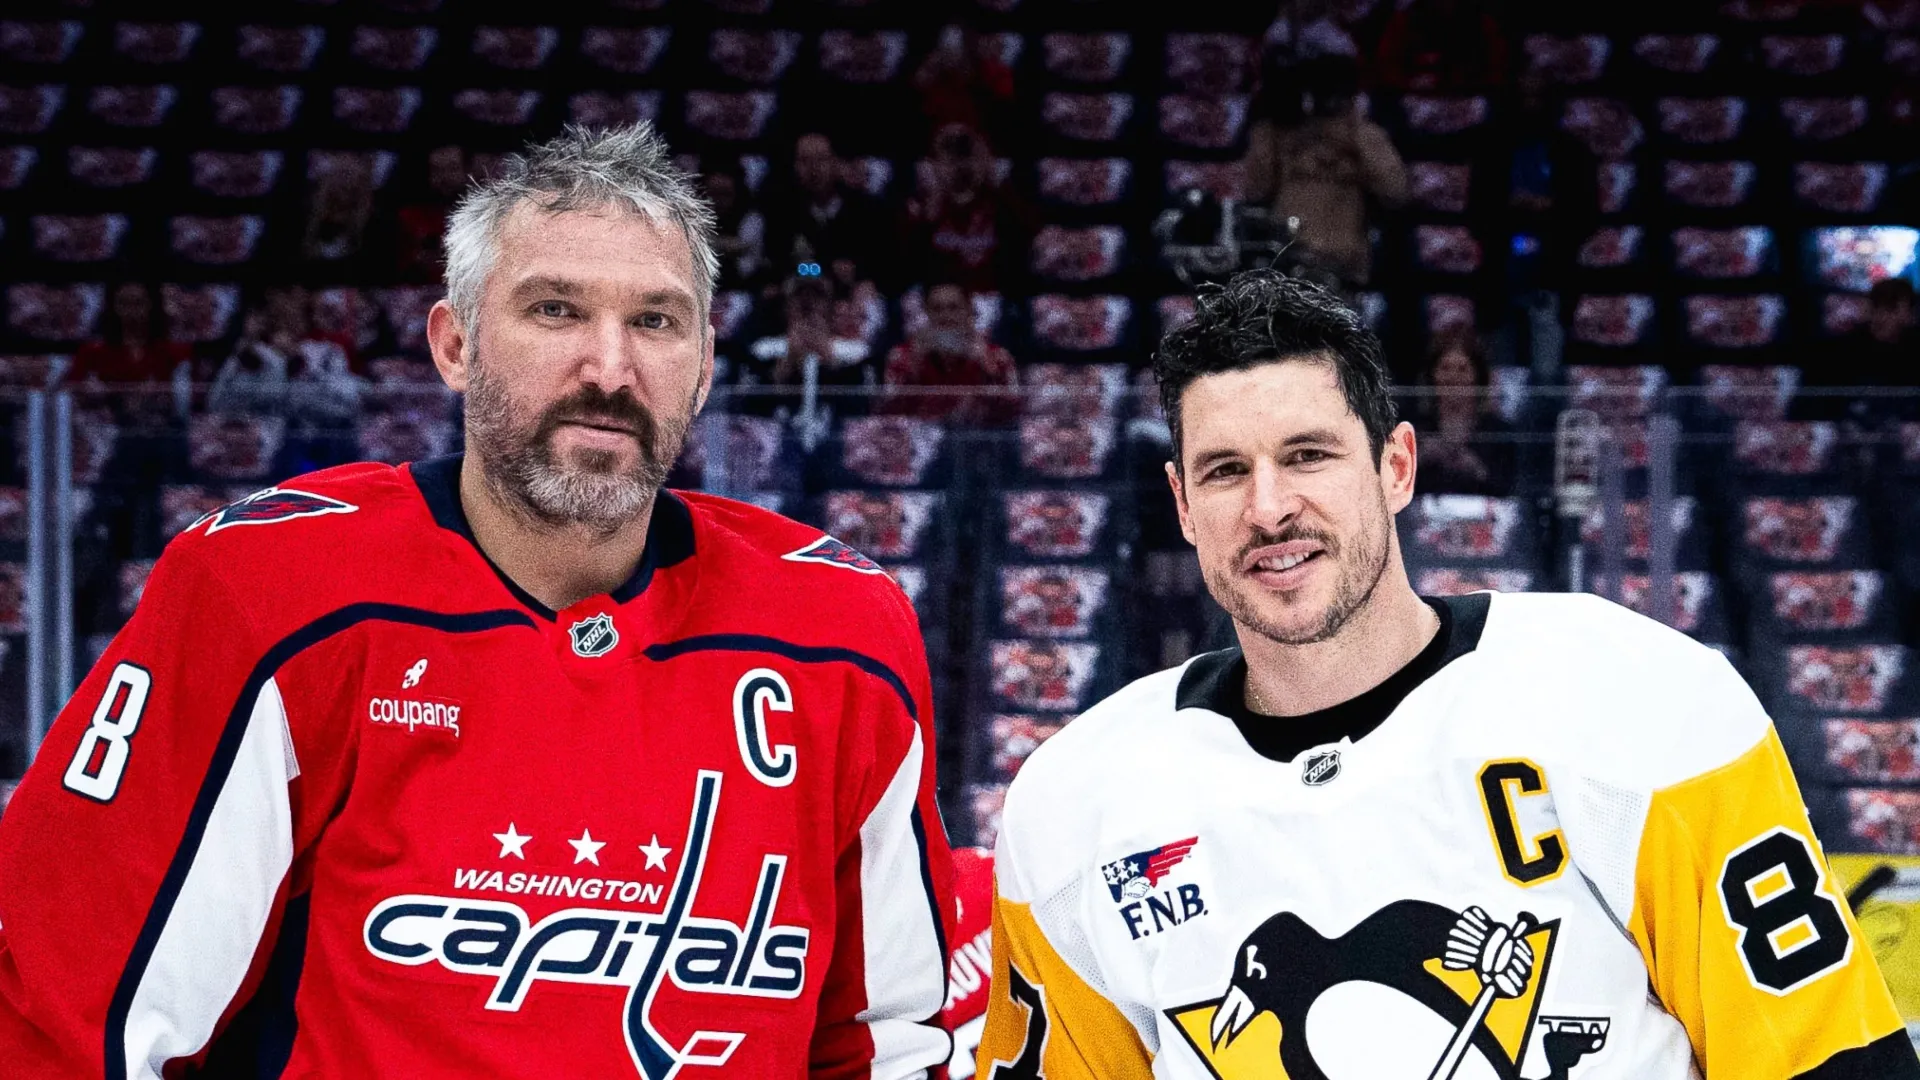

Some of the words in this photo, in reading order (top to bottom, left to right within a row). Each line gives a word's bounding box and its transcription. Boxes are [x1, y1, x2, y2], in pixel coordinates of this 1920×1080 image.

[582, 625, 606, 650] NHL
[63, 660, 153, 804] 8
[369, 696, 460, 738] coupang
[732, 667, 797, 788] C
[1309, 757, 1335, 781] NHL
[1475, 757, 1570, 889] C
[363, 769, 811, 1080] capitals
[453, 868, 665, 905] WASHINGTON
[1118, 883, 1209, 941] F.N.B.
[1716, 825, 1855, 998] 8
